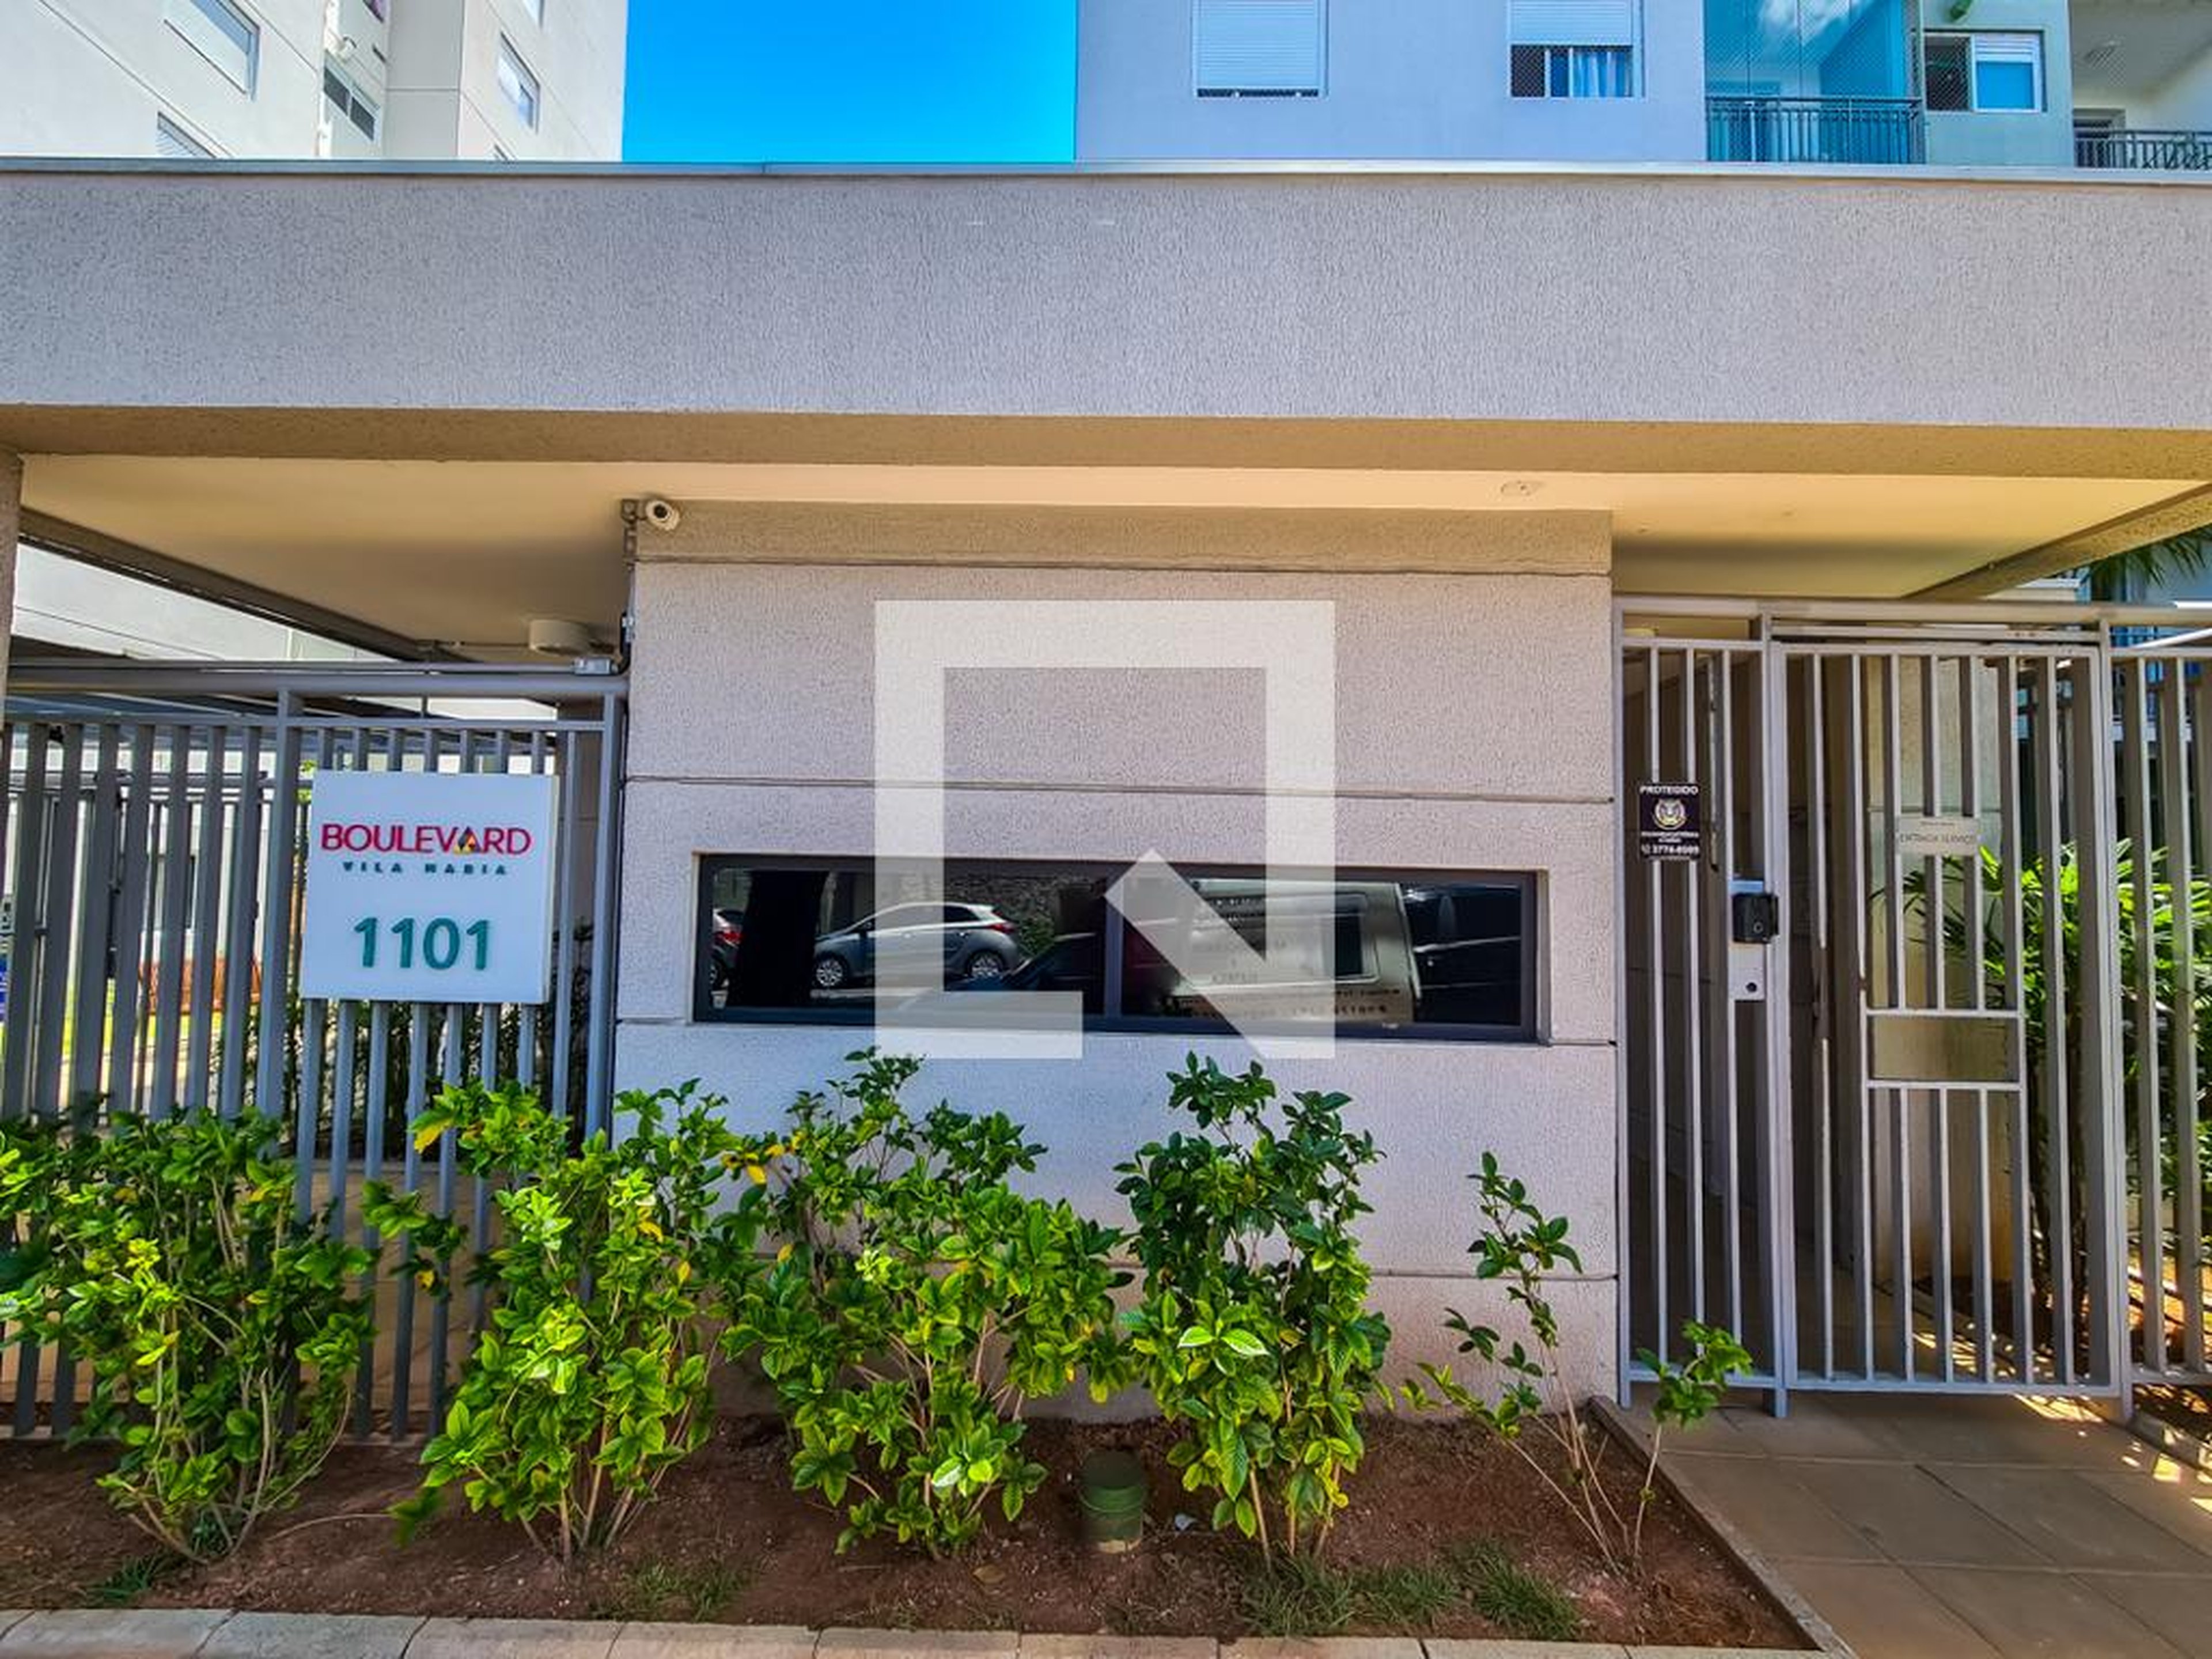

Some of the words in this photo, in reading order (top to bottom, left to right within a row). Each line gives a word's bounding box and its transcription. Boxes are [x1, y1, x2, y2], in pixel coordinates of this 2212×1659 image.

[1640, 786, 1699, 795] PROTEGIDO
[321, 824, 532, 854] BOULEVARD
[342, 861, 402, 873] VILA
[354, 917, 491, 971] 1101
